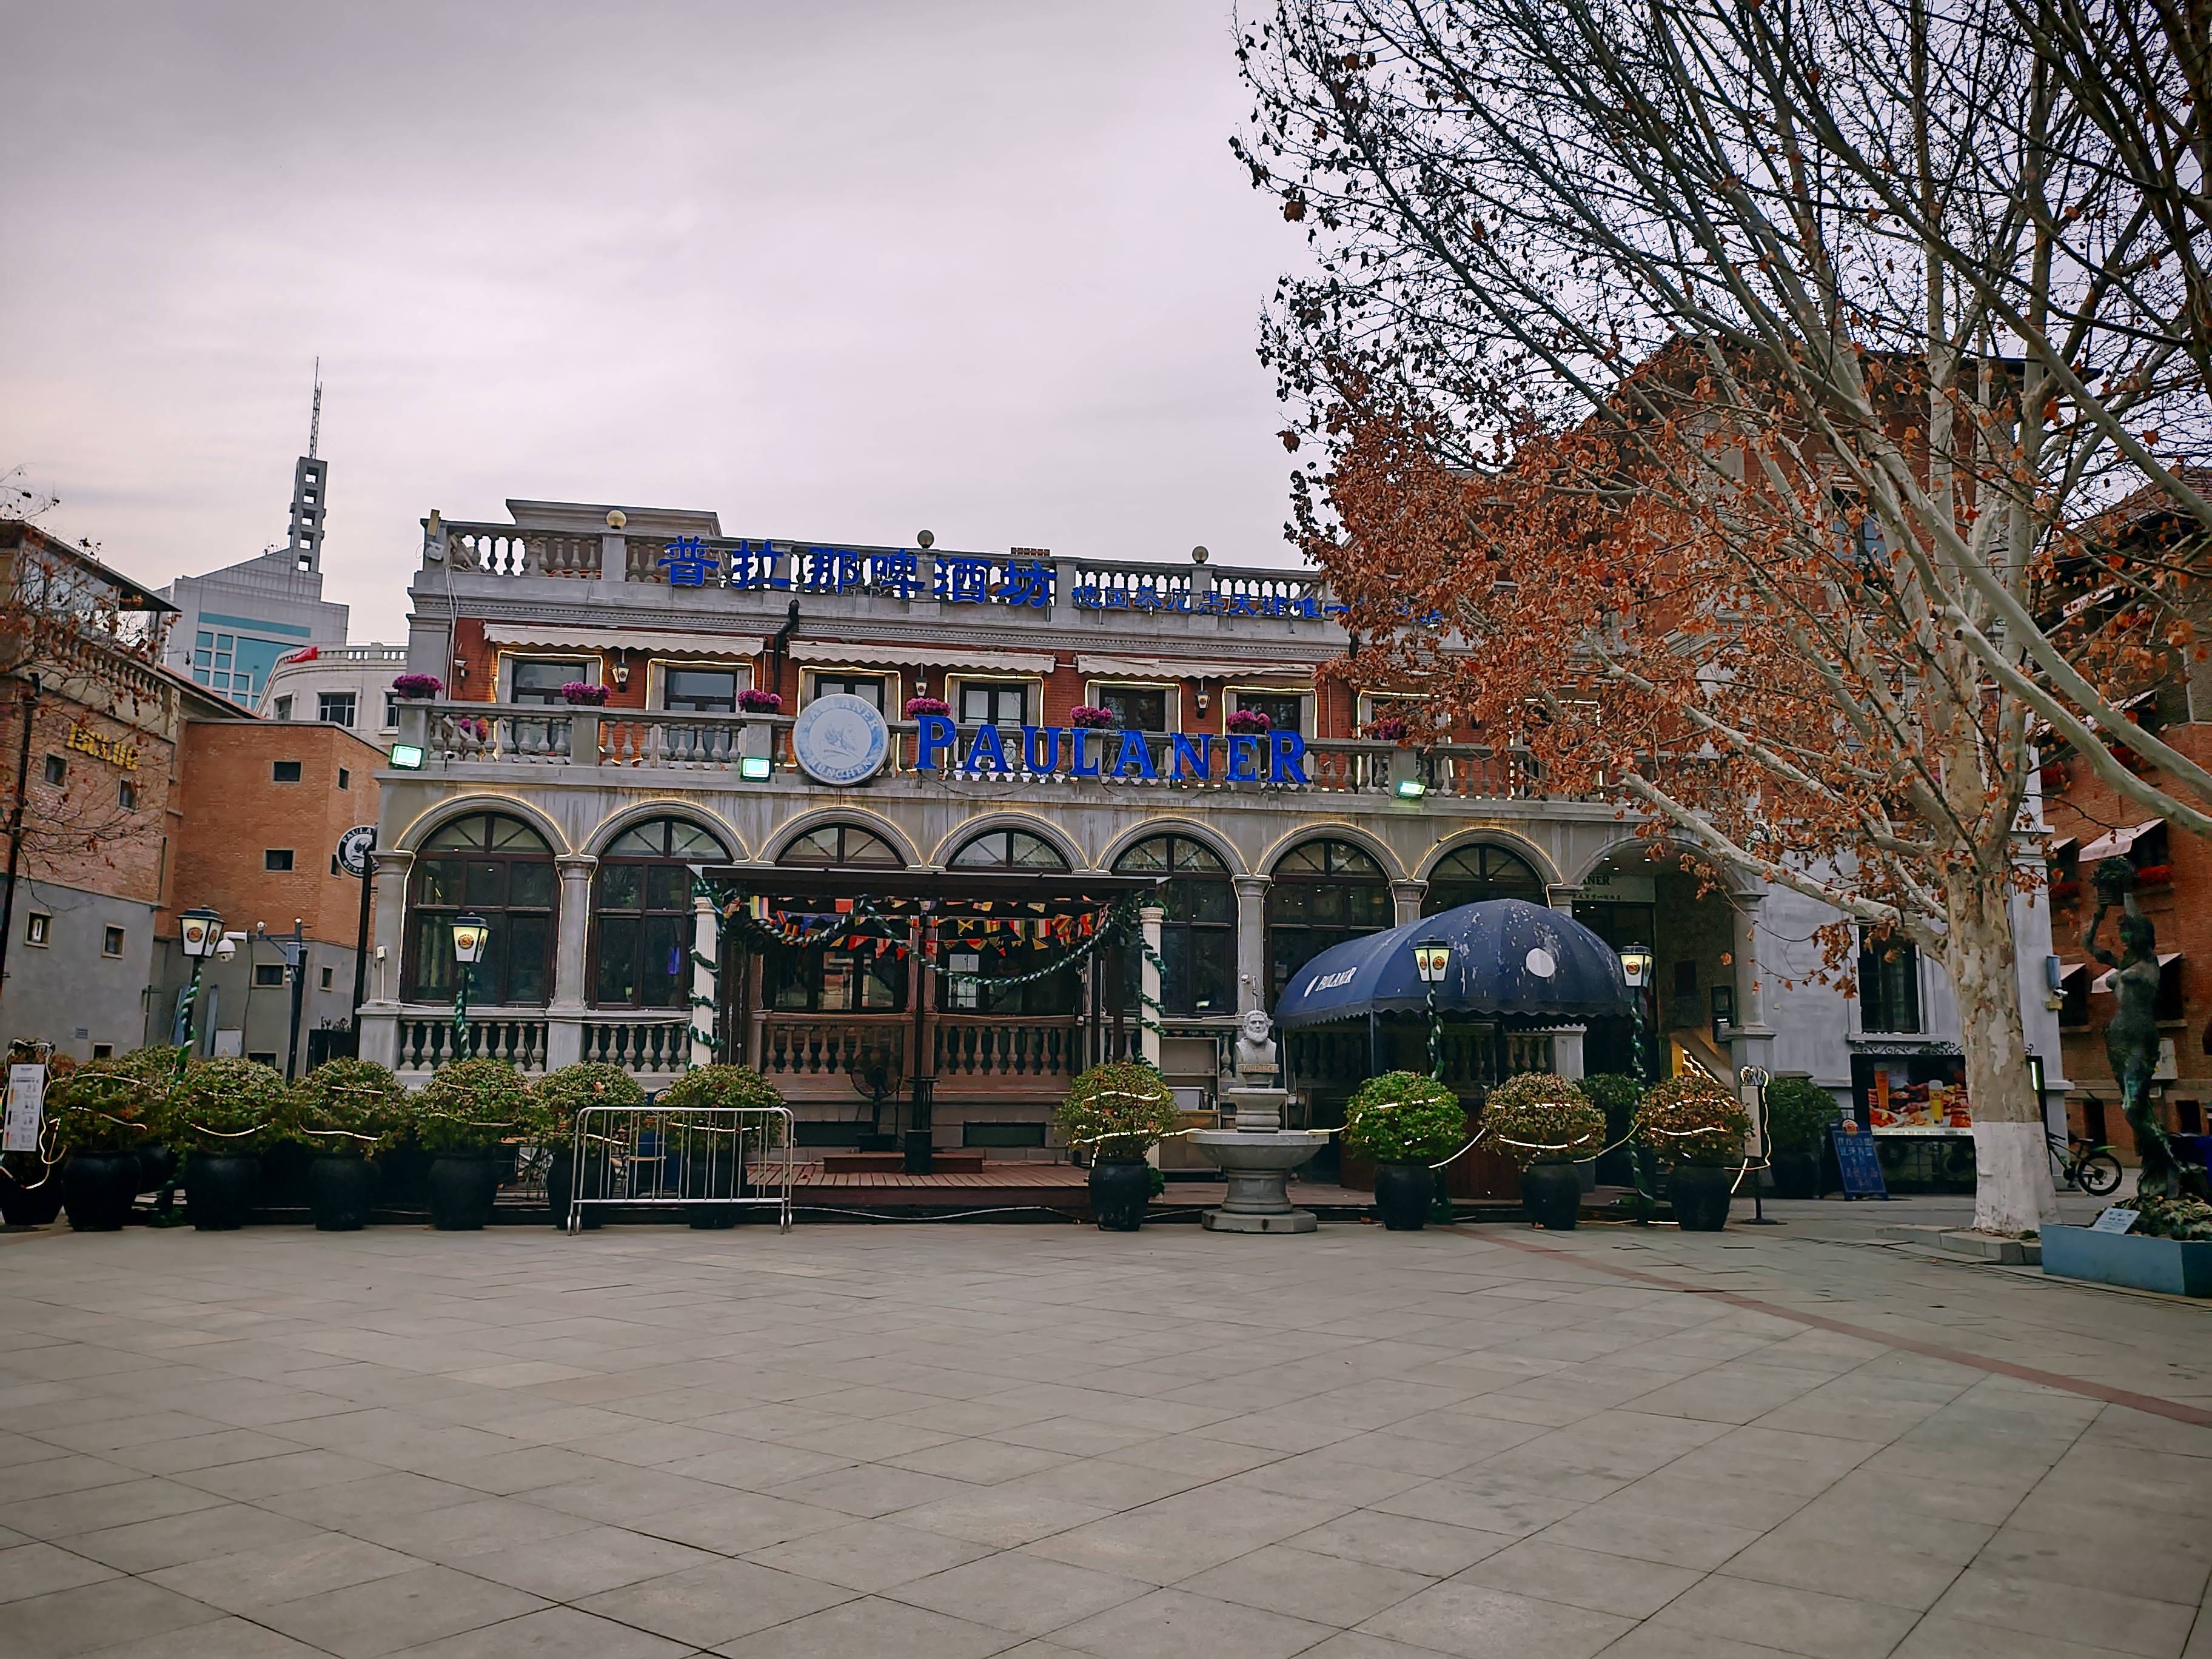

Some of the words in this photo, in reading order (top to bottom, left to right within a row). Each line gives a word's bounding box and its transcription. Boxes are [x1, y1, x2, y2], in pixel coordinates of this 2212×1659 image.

[657, 535, 1057, 608] 普拉那啤酒坊
[914, 714, 1312, 784] PAULANER
[342, 828, 372, 843] PAULA
